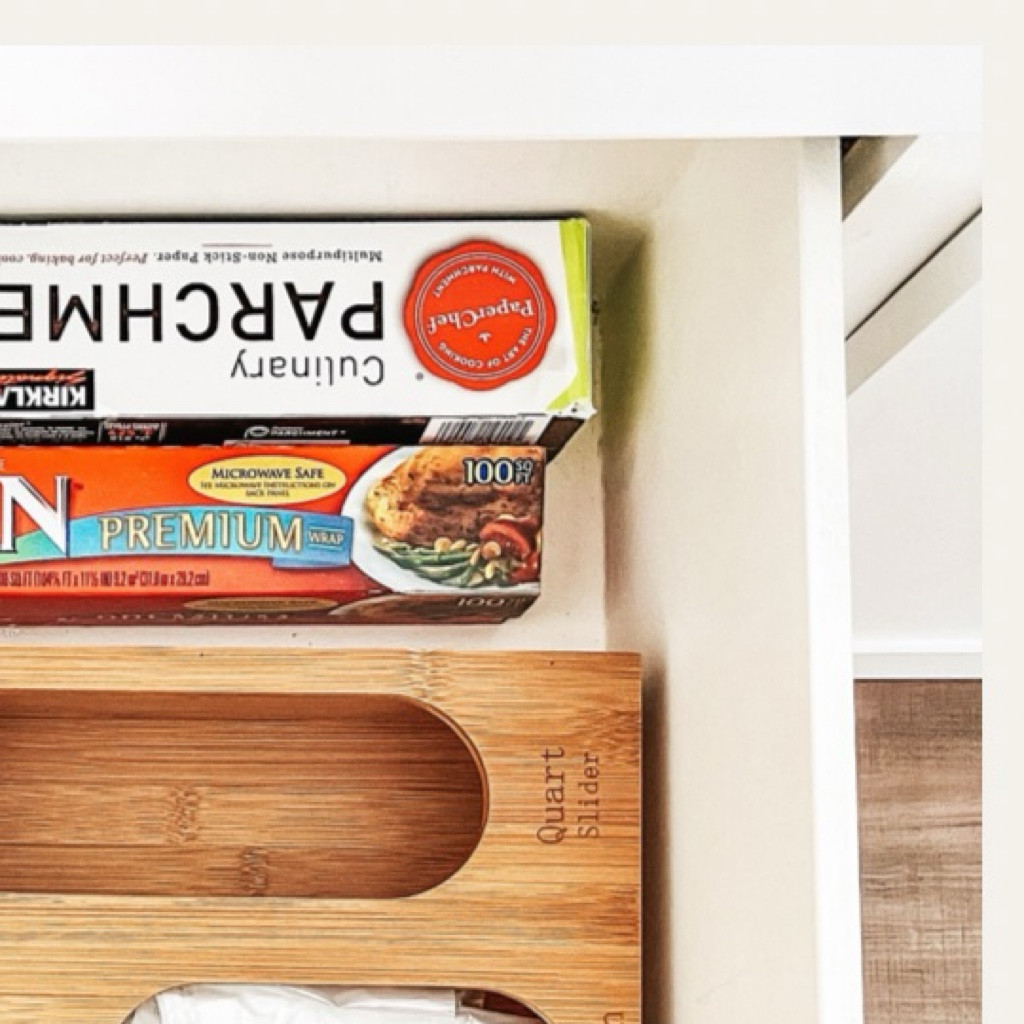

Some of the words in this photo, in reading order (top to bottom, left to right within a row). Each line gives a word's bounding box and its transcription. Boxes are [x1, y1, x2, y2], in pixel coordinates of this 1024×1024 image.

[30, 251, 74, 264] baking,
[77, 251, 98, 265] for
[101, 252, 149, 265] Perfect
[203, 250, 278, 263] Non-Stick
[282, 250, 384, 263] Multipurpose
[433, 265, 489, 298] PARCHMENT
[491, 266, 517, 285] WITH
[427, 298, 535, 335] PaperChef
[518, 327, 533, 346] THE
[438, 342, 484, 368] COOKING
[504, 346, 519, 362] ART
[230, 349, 384, 386] Culinary
[487, 358, 501, 368] OF
[212, 467, 292, 479] MICROWAVE
[295, 466, 324, 479] SAFE
[463, 458, 514, 484] 100
[515, 460, 534, 471] SQ
[516, 471, 531, 483] FT
[98, 511, 303, 552] PREMIUM
[308, 530, 344, 544] WRAP
[537, 746, 568, 844] Quart
[577, 752, 600, 839] Slider
